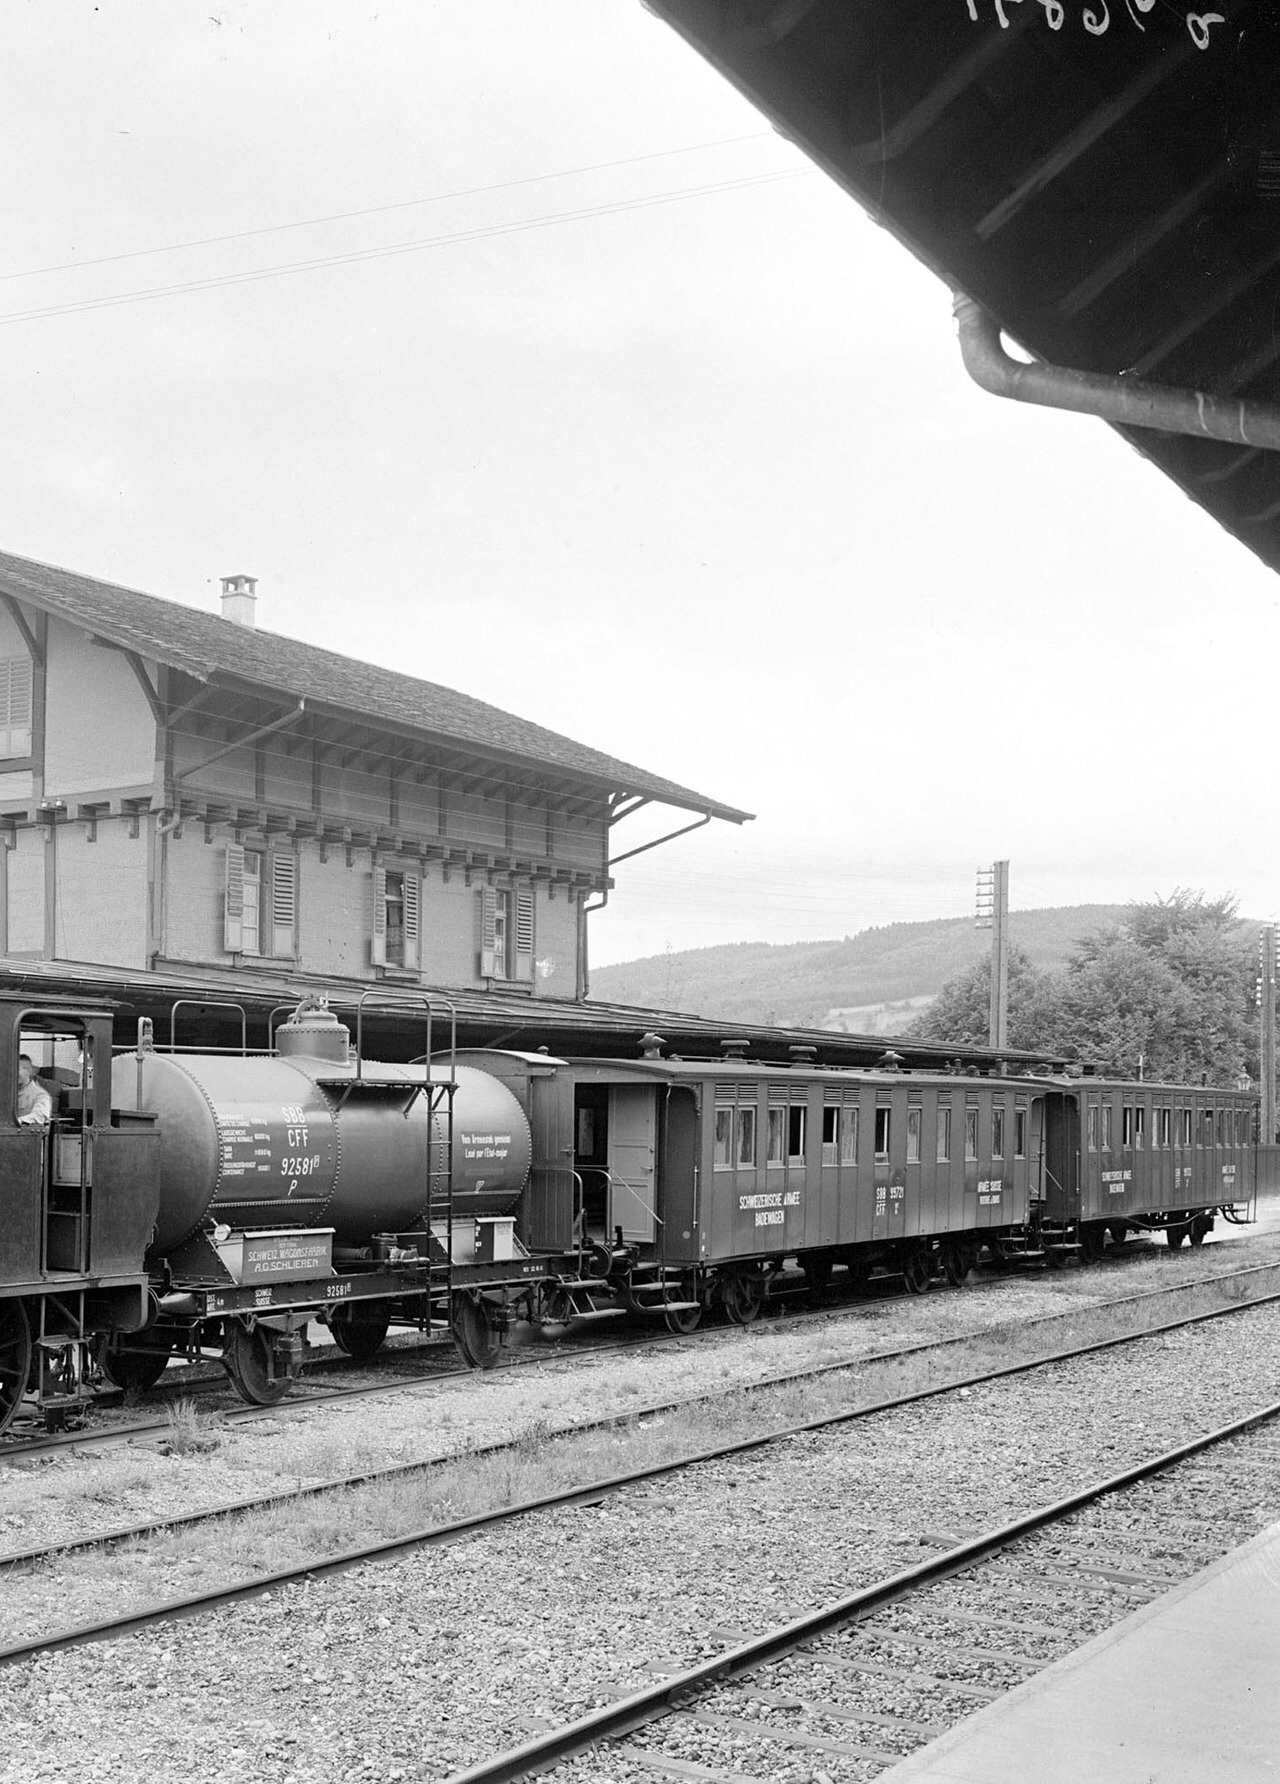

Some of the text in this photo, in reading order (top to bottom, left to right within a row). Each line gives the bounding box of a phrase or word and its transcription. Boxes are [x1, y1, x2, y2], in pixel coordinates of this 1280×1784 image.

[281, 1106, 306, 1124] SBB
[287, 1129, 309, 1147] CFF
[281, 1157, 314, 1176] 92581
[288, 1179, 298, 1196] P
[876, 1187, 886, 1200] SBB
[739, 1191, 801, 1209] SCHWEIZERISCHE ARMEE
[876, 1203, 886, 1216] CFF
[271, 1259, 319, 1271] SCHLIEREN
[326, 1284, 347, 1297] 92581
